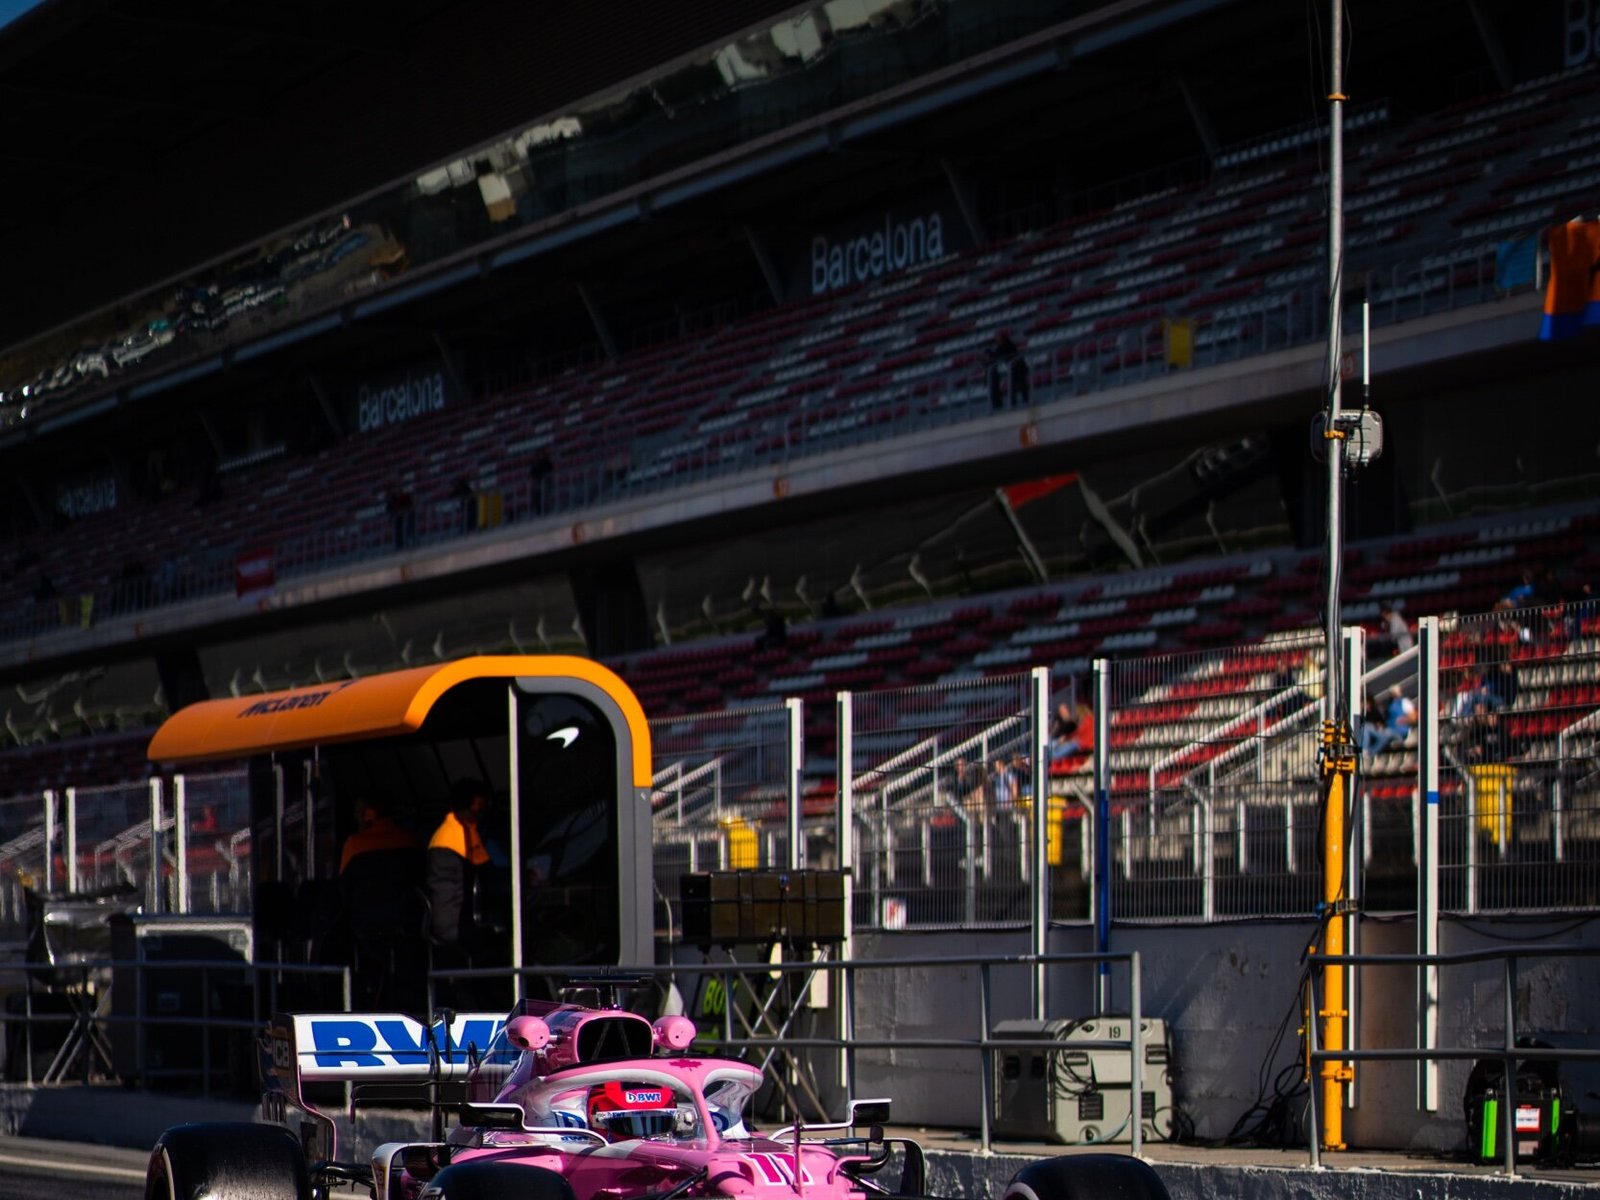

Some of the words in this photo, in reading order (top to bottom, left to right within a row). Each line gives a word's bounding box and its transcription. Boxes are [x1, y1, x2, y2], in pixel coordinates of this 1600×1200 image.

[811, 210, 944, 294] Barcelona
[358, 371, 444, 431] Barcelona
[1109, 1026, 1121, 1039] 19
[638, 1093, 660, 1101] BWT
[744, 1153, 813, 1186] 11
